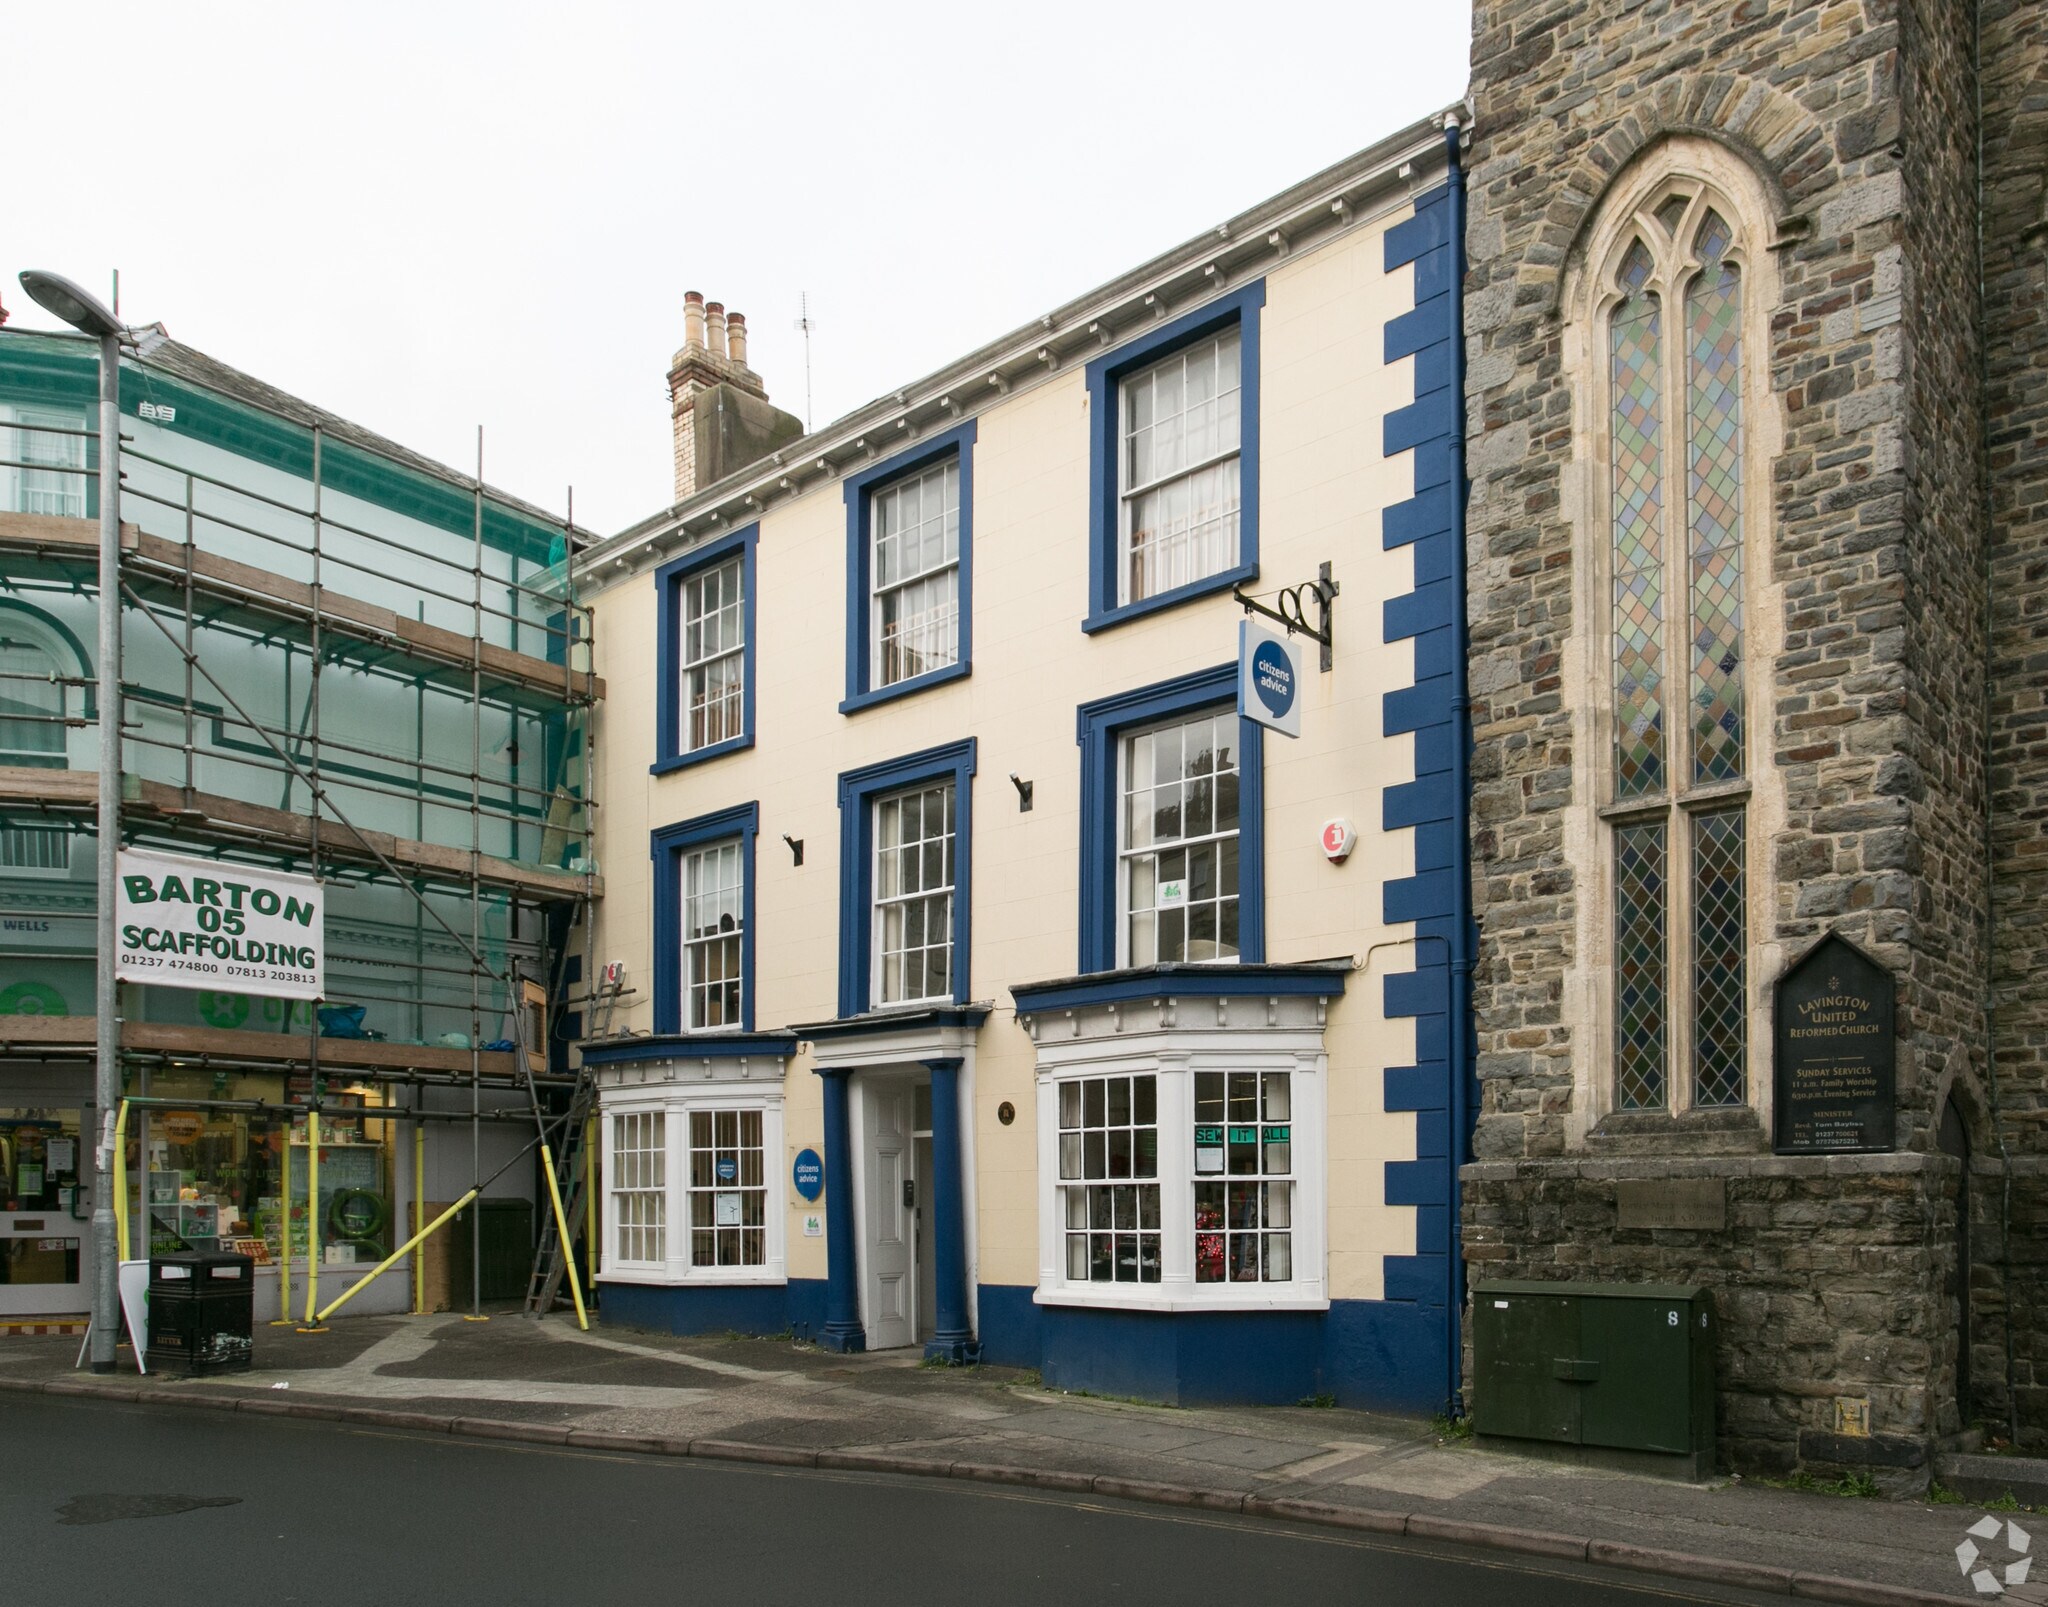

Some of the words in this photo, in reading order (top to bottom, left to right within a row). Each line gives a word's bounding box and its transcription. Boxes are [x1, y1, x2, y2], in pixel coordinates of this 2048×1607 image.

[1258, 659, 1290, 682] citizens
[1260, 676, 1288, 695] advice
[122, 874, 315, 927] BARTON
[3, 919, 50, 932] WELLS
[197, 905, 246, 936] 05
[122, 924, 316, 969] SCAFFOLDING
[121, 954, 164, 967] 01237
[168, 960, 218, 973] 474800
[227, 966, 266, 978] 07813
[270, 971, 316, 984] 203813
[1798, 995, 1870, 1015] LAVINGTON
[1811, 1011, 1857, 1023] UNITED
[1790, 1027, 1838, 1038] REFORMED
[1839, 1024, 1879, 1035] CHURCH
[1796, 1068, 1831, 1078] SUNDAY
[1833, 1066, 1872, 1076] SERVICES
[1820, 1079, 1844, 1087] Family
[1846, 1077, 1877, 1086] Worship
[1852, 1088, 1876, 1096] Service
[1812, 1110, 1853, 1118] MINISTER
[1196, 1129, 1223, 1141] SEW
[1237, 1129, 1249, 1142] IT
[1262, 1127, 1289, 1140] ALL
[797, 1164, 820, 1173] citizens
[798, 1174, 818, 1183] advice
